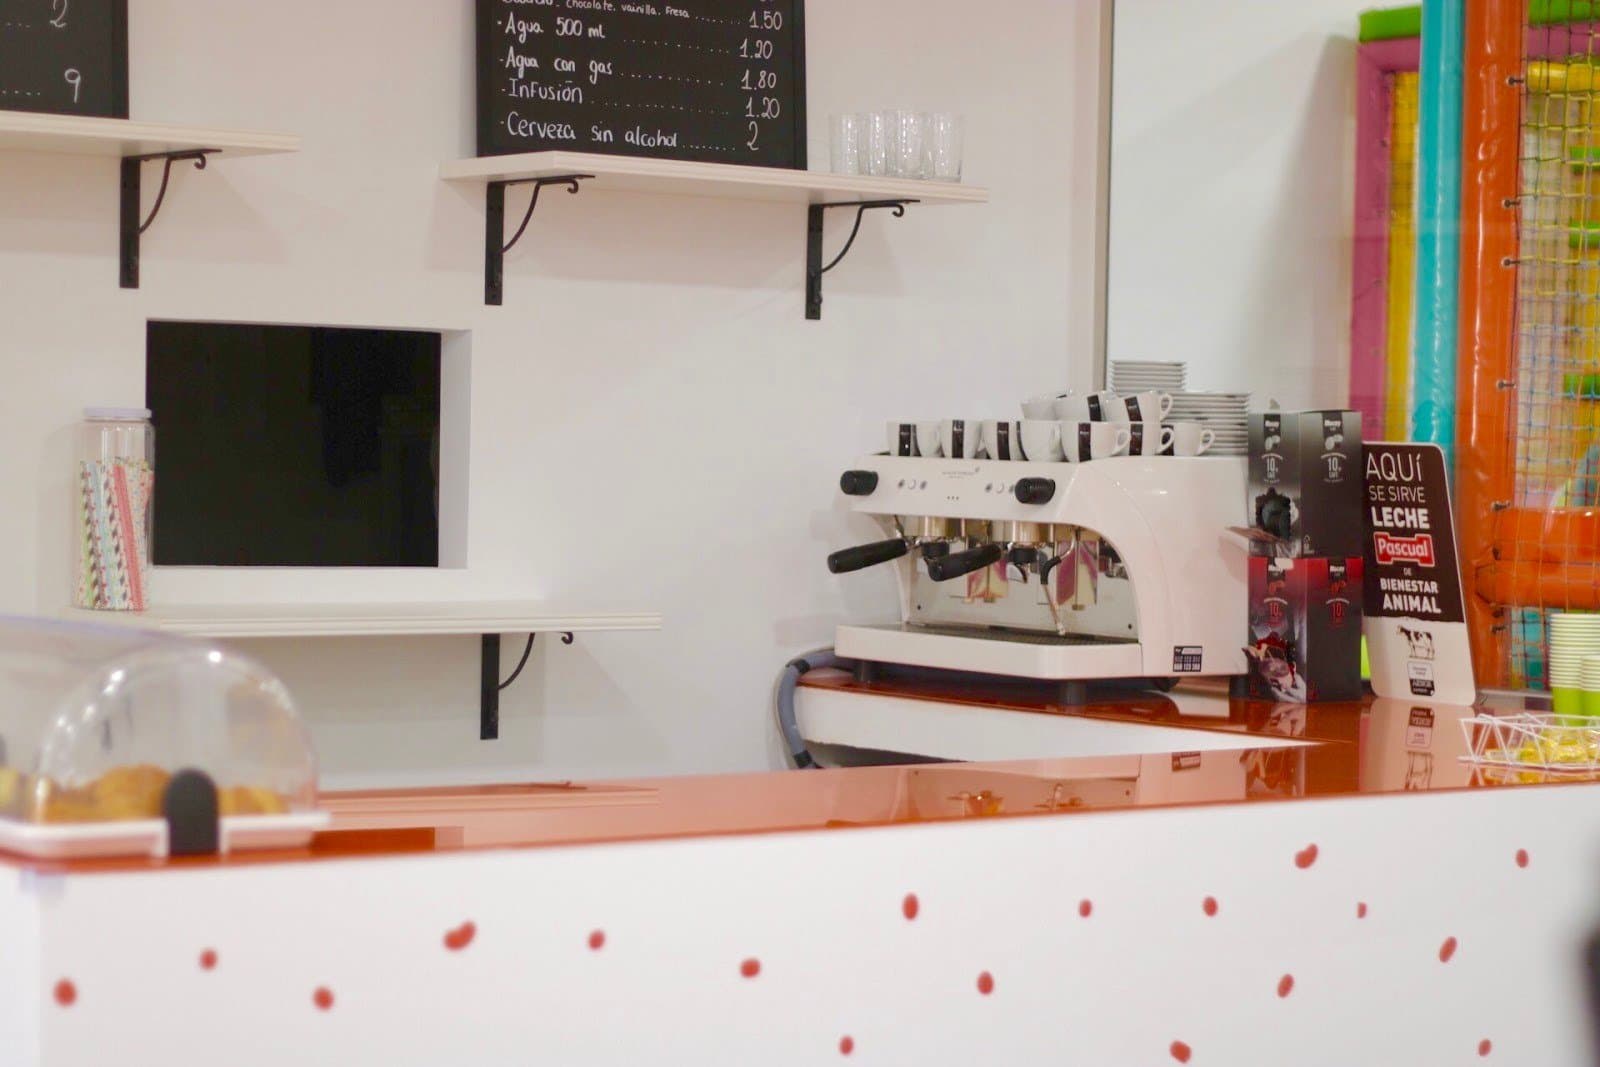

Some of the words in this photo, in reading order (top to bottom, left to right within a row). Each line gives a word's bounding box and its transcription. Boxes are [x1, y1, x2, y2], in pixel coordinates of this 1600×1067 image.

[749, 10, 782, 31] 1.50
[505, 11, 544, 44] Agua
[556, 17, 583, 37] 500
[739, 38, 773, 60] 1.20
[554, 58, 576, 72] con
[589, 60, 613, 85] gas
[741, 69, 777, 91] 1.80
[64, 68, 81, 104] 9
[745, 97, 781, 119] 1.20
[507, 111, 577, 140] Cerveza
[624, 126, 678, 148] alcohol
[746, 121, 760, 151] 2
[1369, 485, 1386, 501] SE
[1388, 486, 1427, 503] SIRVE
[1371, 506, 1431, 529] LECHE
[1377, 537, 1429, 558] Pascual
[1403, 567, 1413, 577] DE
[1380, 577, 1439, 594] BIENESTAR
[1382, 593, 1442, 614] ANIMAL
